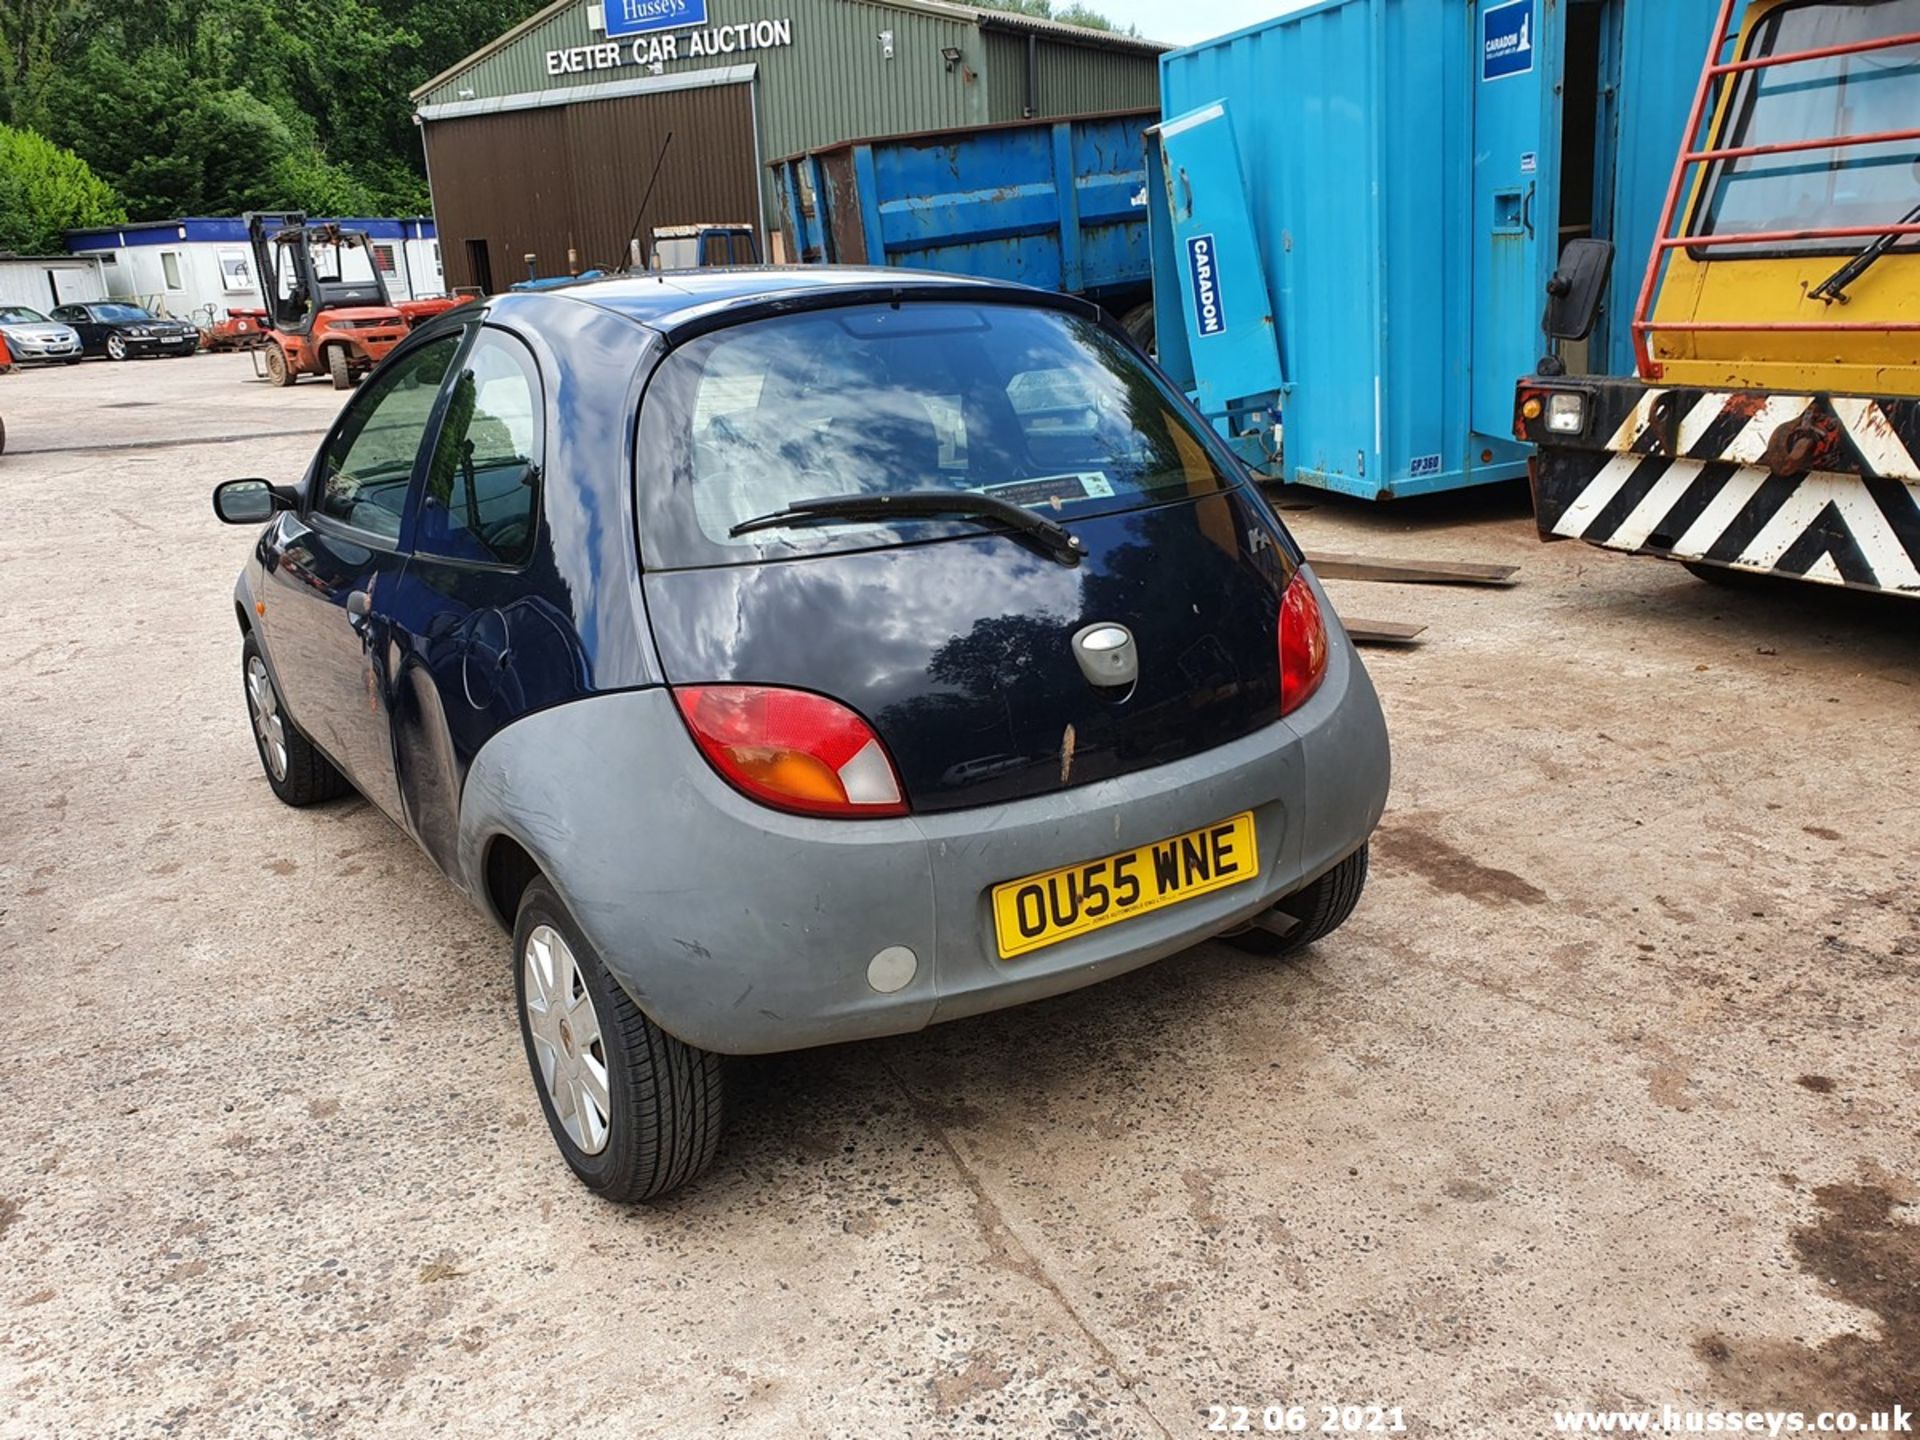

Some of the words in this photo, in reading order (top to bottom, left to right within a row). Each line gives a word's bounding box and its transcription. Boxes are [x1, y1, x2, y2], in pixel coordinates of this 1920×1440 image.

[622, 0, 686, 20] Husseys
[546, 42, 621, 75] EXETER
[633, 34, 677, 65] CAR
[690, 18, 791, 57] AUCTION
[1486, 32, 1517, 53] CARADON
[1194, 240, 1218, 332] CARADON
[1016, 854, 1140, 938] OU55
[1153, 824, 1238, 895] WNE
